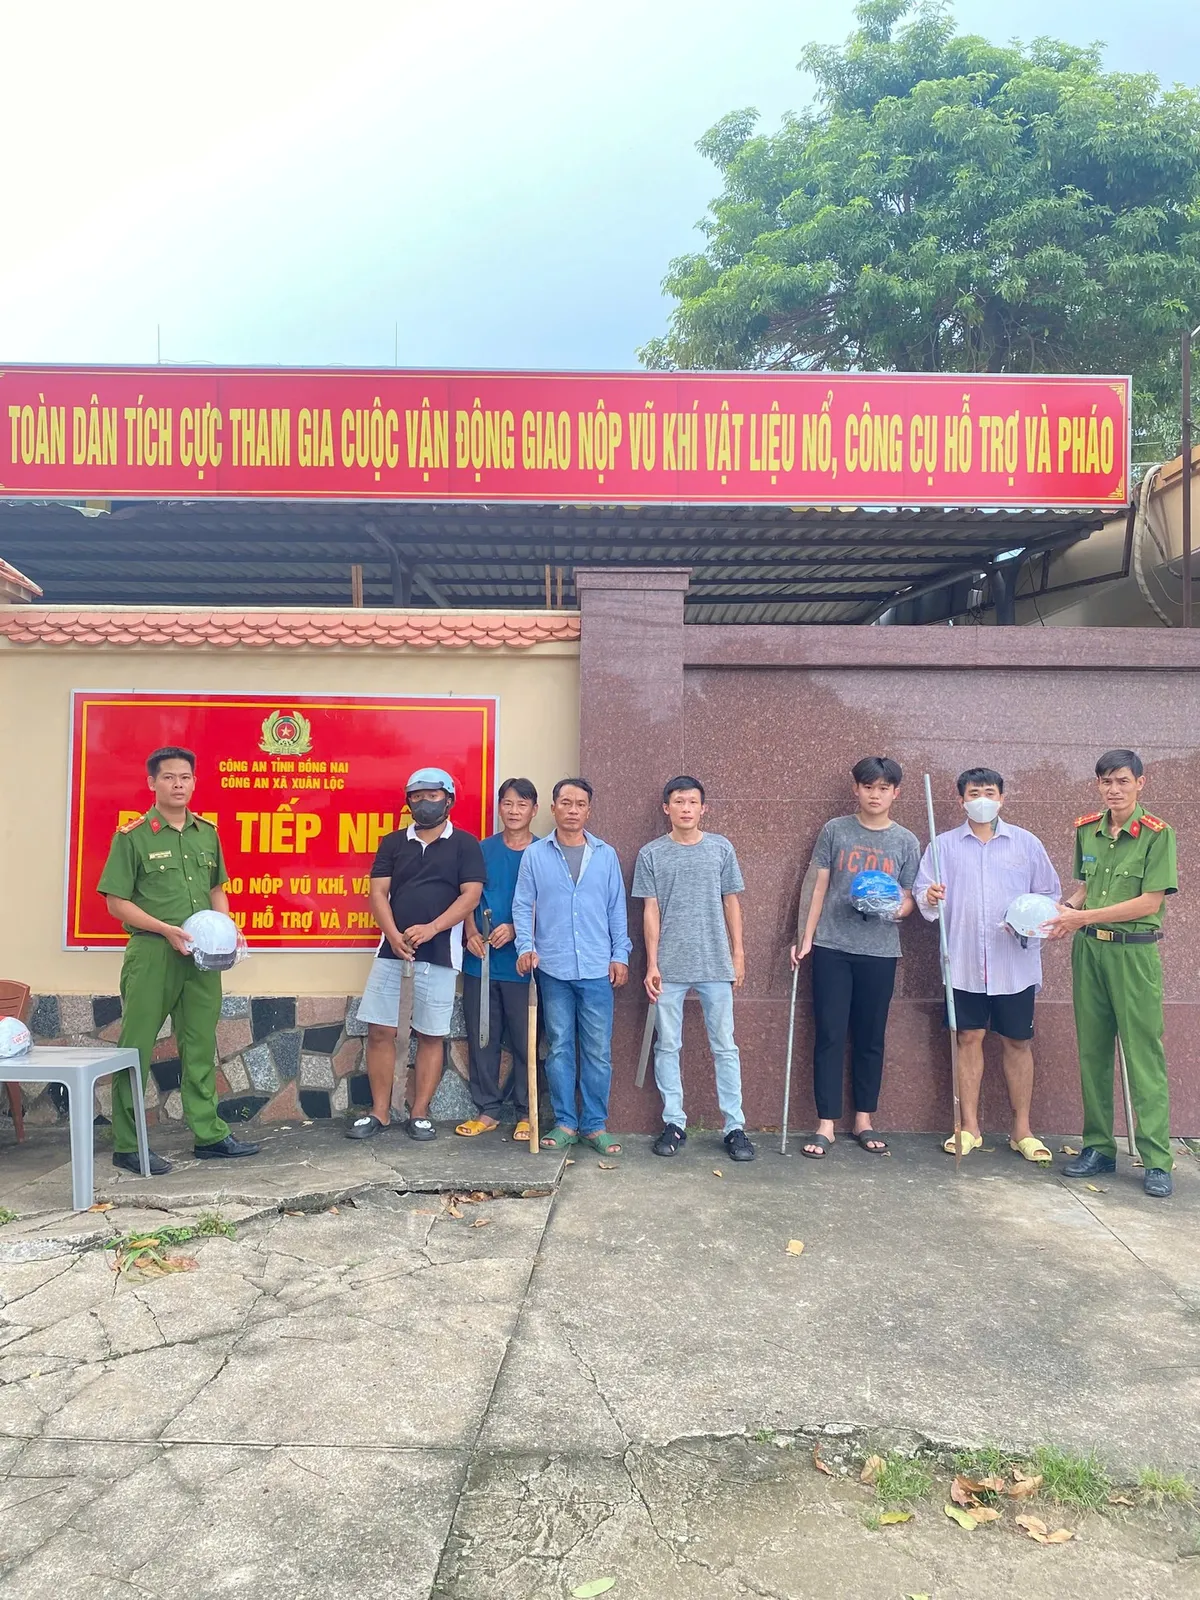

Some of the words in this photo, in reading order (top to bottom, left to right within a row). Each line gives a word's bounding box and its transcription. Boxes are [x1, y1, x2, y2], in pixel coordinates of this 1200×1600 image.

[8, 393, 66, 465] TOÀN
[73, 393, 117, 465] DÂN
[124, 394, 172, 466] TÍCH
[180, 402, 222, 480] CỰC
[229, 408, 290, 466] THAM
[298, 408, 334, 467] GIA
[341, 396, 399, 481] CUỘC
[405, 397, 449, 482] VẬN
[455, 397, 515, 482] ĐỘNG
[522, 410, 571, 470] GIAO
[578, 399, 622, 484] NỘP
[629, 401, 655, 471] VŨ
[664, 400, 698, 470] KHÍ
[705, 401, 743, 484] VẬT
[750, 401, 795, 484] LIỆU
[802, 390, 837, 479] NỔ,
[846, 402, 902, 472] CÔNG
[910, 415, 937, 485] CỤ
[945, 394, 972, 472] HỖ
[979, 410, 1019, 486] TRỢ
[1025, 404, 1051, 472] VÀ
[1058, 404, 1114, 474] PHÁO
[220, 759, 247, 772] CÔNG
[252, 761, 266, 772] AN
[272, 757, 294, 772] TỈNH
[330, 762, 348, 773] NAI
[222, 775, 250, 788] CÔNG
[254, 778, 269, 788] AN
[273, 776, 287, 788] XÃ
[292, 776, 320, 789] XUÂN
[324, 776, 344, 791] LỘC
[236, 797, 322, 854] TIẾP
[838, 850, 894, 874] ICON
[222, 877, 243, 894] AO
[249, 874, 283, 898] NỘP
[290, 874, 312, 895] VŨ
[317, 874, 348, 896] KHÍ,
[352, 874, 371, 898] VẬ
[252, 905, 274, 929] HỖ
[281, 911, 313, 932] TRỢ
[319, 908, 340, 928] VÀ
[347, 912, 380, 929] PH
